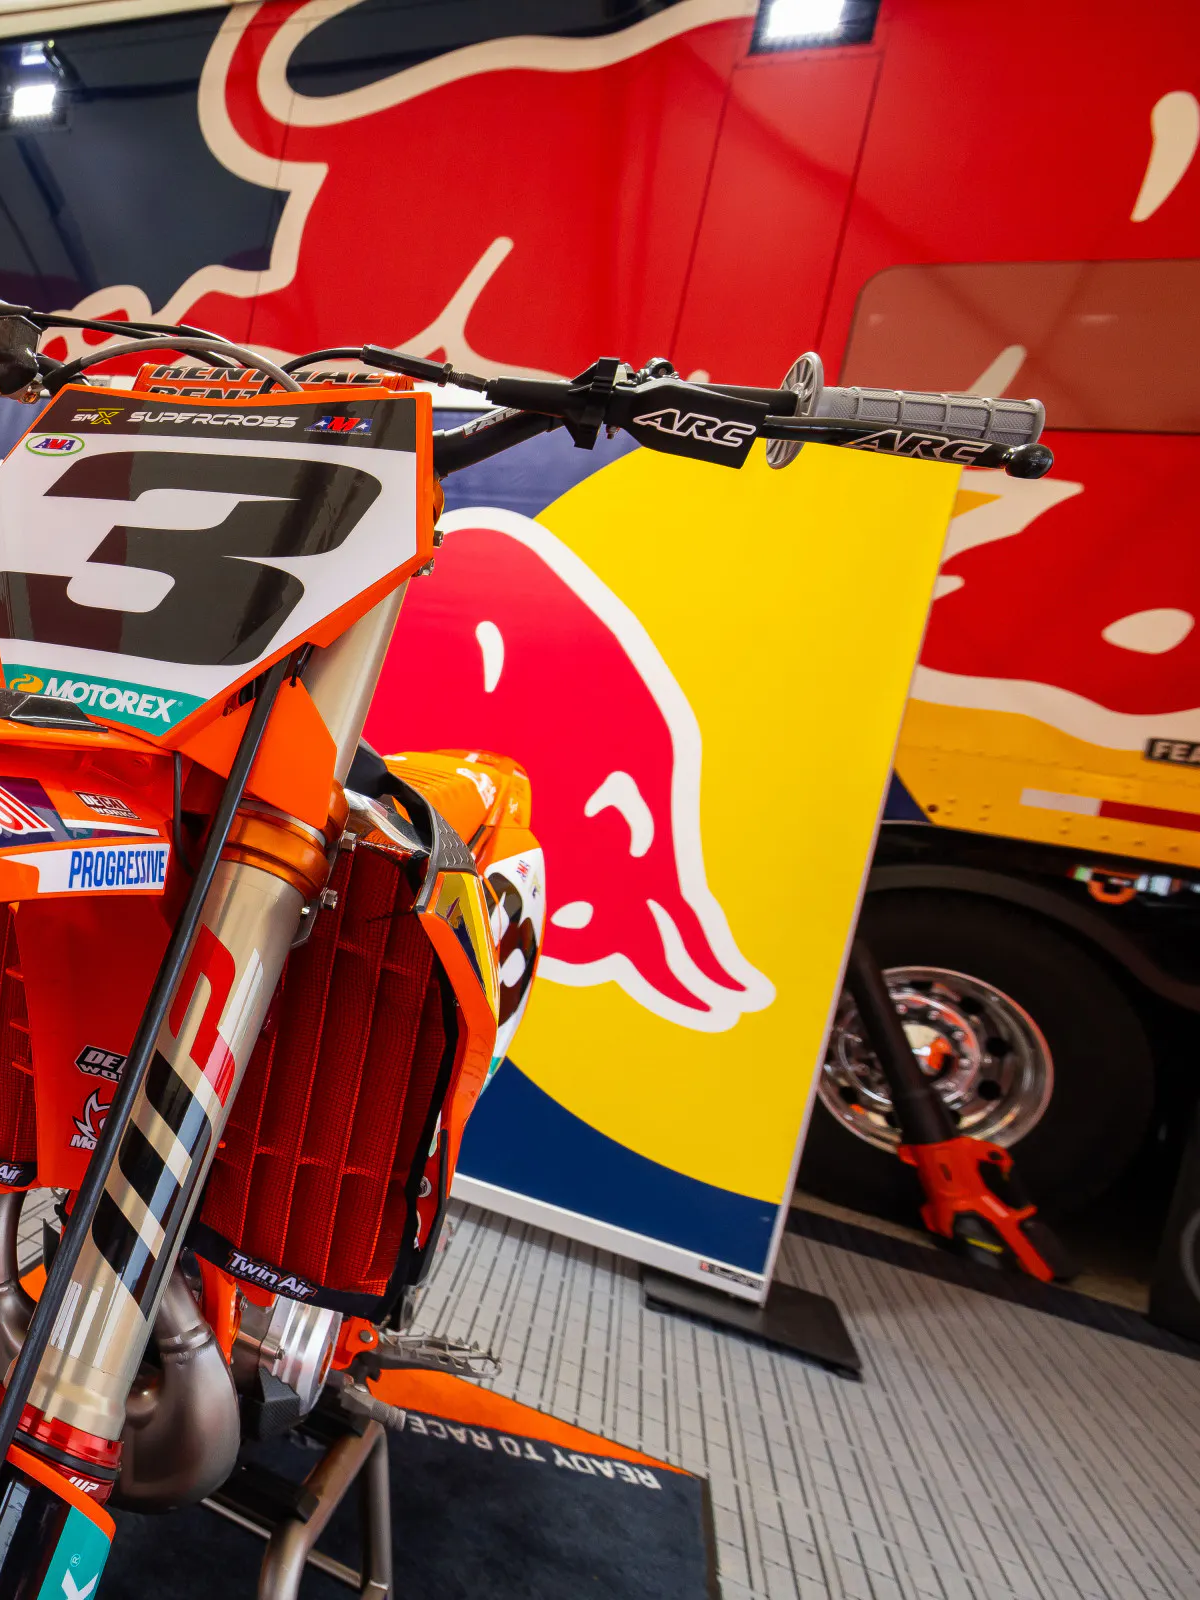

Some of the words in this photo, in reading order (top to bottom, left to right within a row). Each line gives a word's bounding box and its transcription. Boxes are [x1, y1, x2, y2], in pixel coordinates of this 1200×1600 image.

[71, 411, 120, 425] SMX
[126, 411, 300, 429] SUPERCROSS
[305, 415, 373, 432] AMA
[632, 408, 757, 448] ARC
[32, 437, 76, 451] AMA
[841, 429, 992, 464] ARC
[43, 677, 178, 723] MOTOREX
[78, 793, 130, 811] DECAL
[68, 849, 166, 889] PROGRESSIVE
[230, 1252, 278, 1285] Twin
[277, 1276, 313, 1296] Air
[406, 1413, 494, 1451] RACE
[497, 1435, 548, 1463] TO
[552, 1448, 663, 1491] READY
